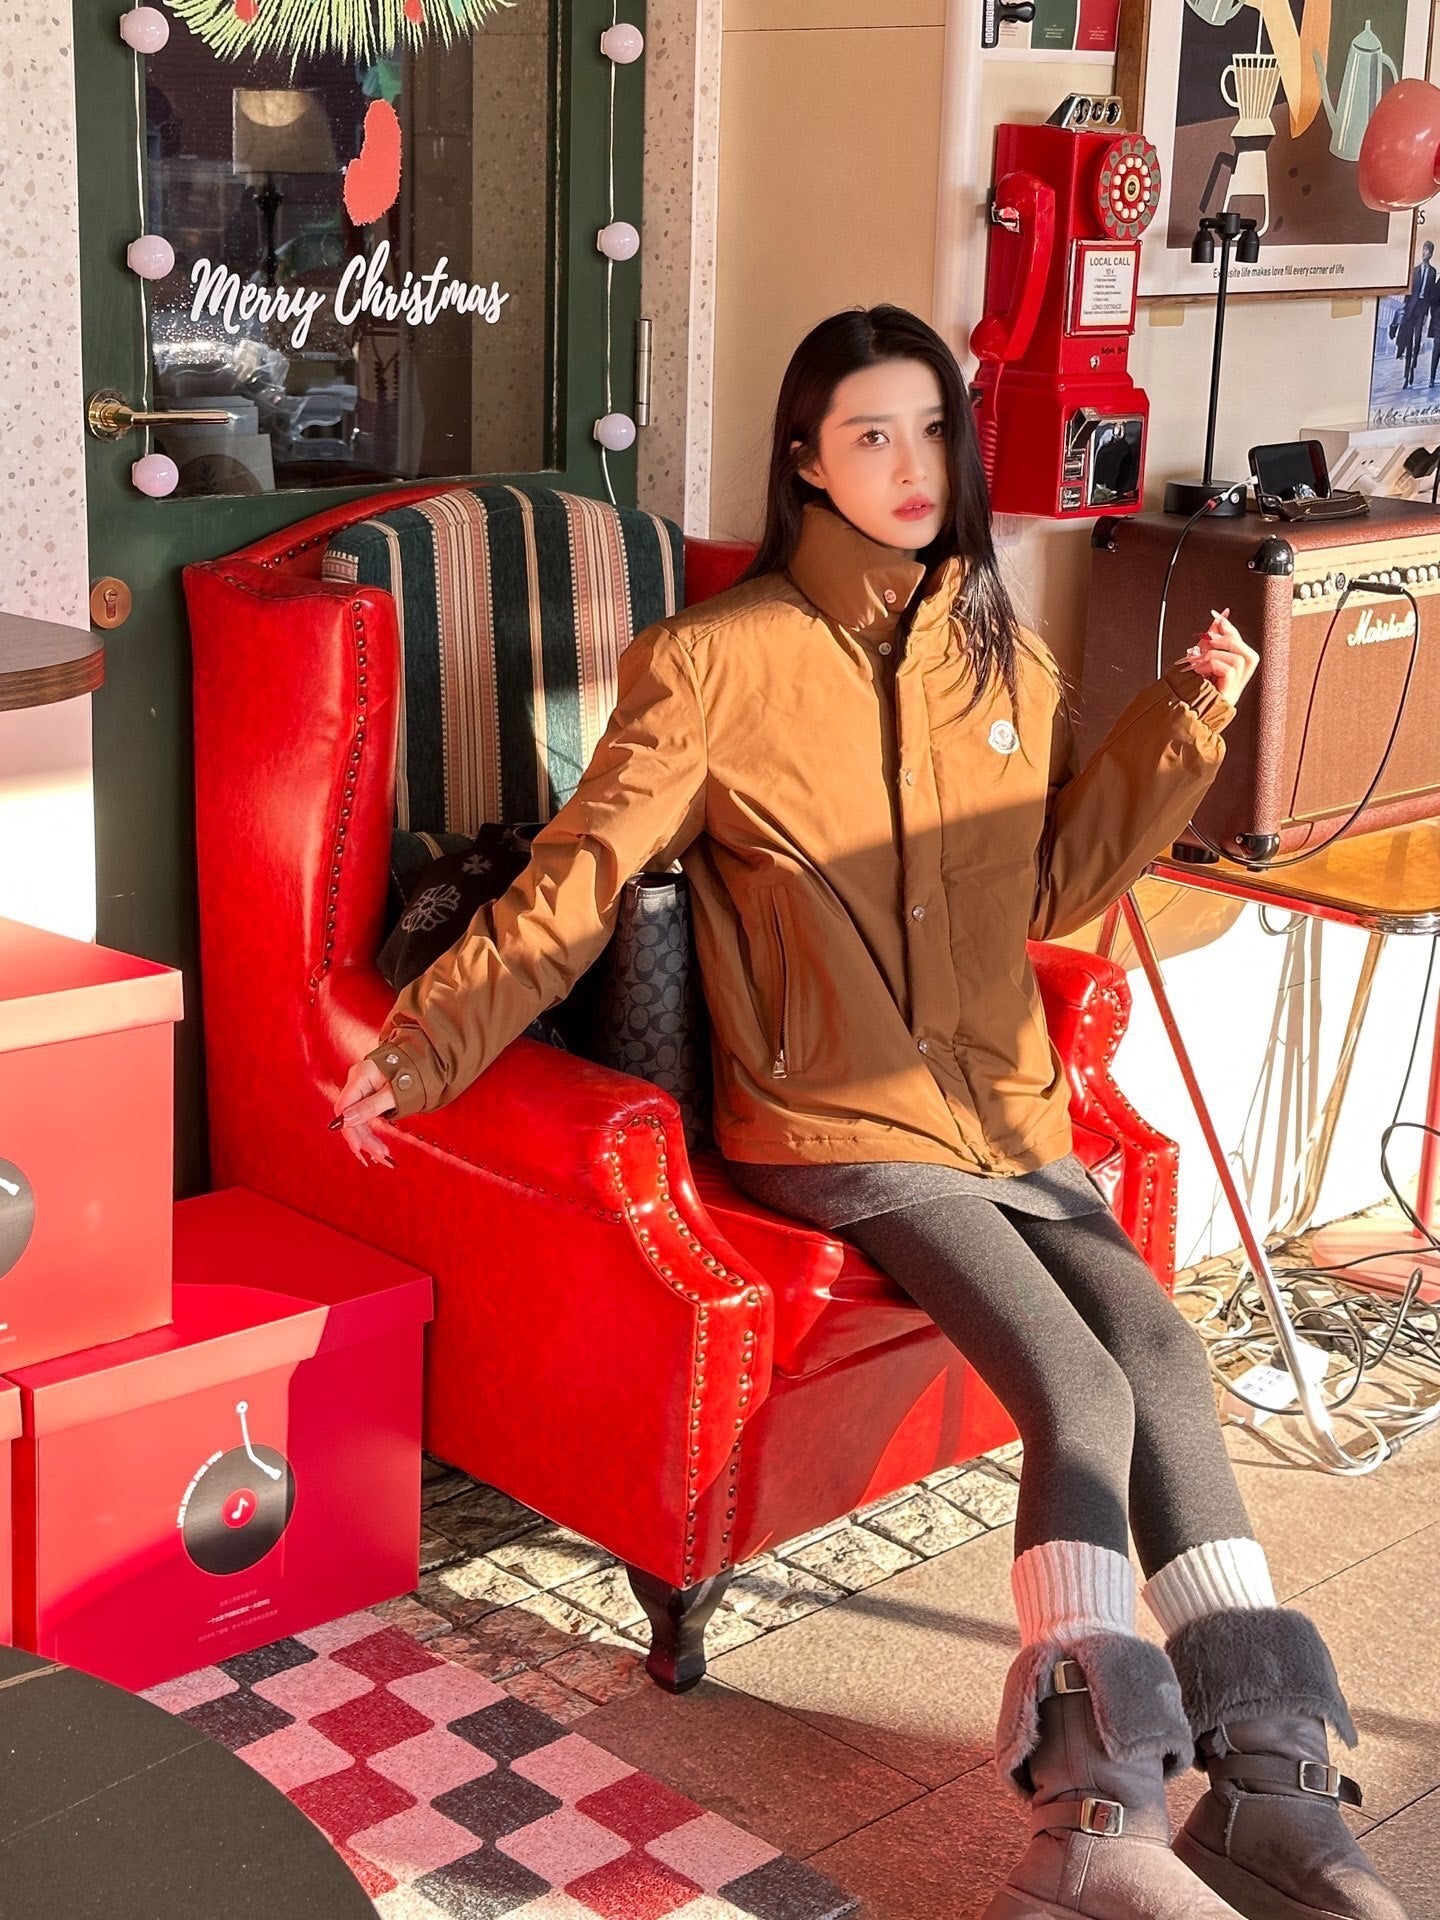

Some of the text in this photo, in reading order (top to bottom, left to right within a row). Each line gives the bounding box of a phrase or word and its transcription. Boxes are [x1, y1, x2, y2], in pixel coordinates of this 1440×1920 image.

[1089, 257, 1131, 266] LOCAL CALL
[1213, 268, 1240, 278] Exsite
[1241, 267, 1251, 277] life
[1251, 266, 1272, 277] makes
[1272, 266, 1284, 276] love
[1293, 266, 1309, 277] every
[1309, 265, 1329, 275] corner
[1329, 264, 1336, 274] of
[1335, 264, 1345, 274] life
[190, 240, 510, 349] Merry Christmas
